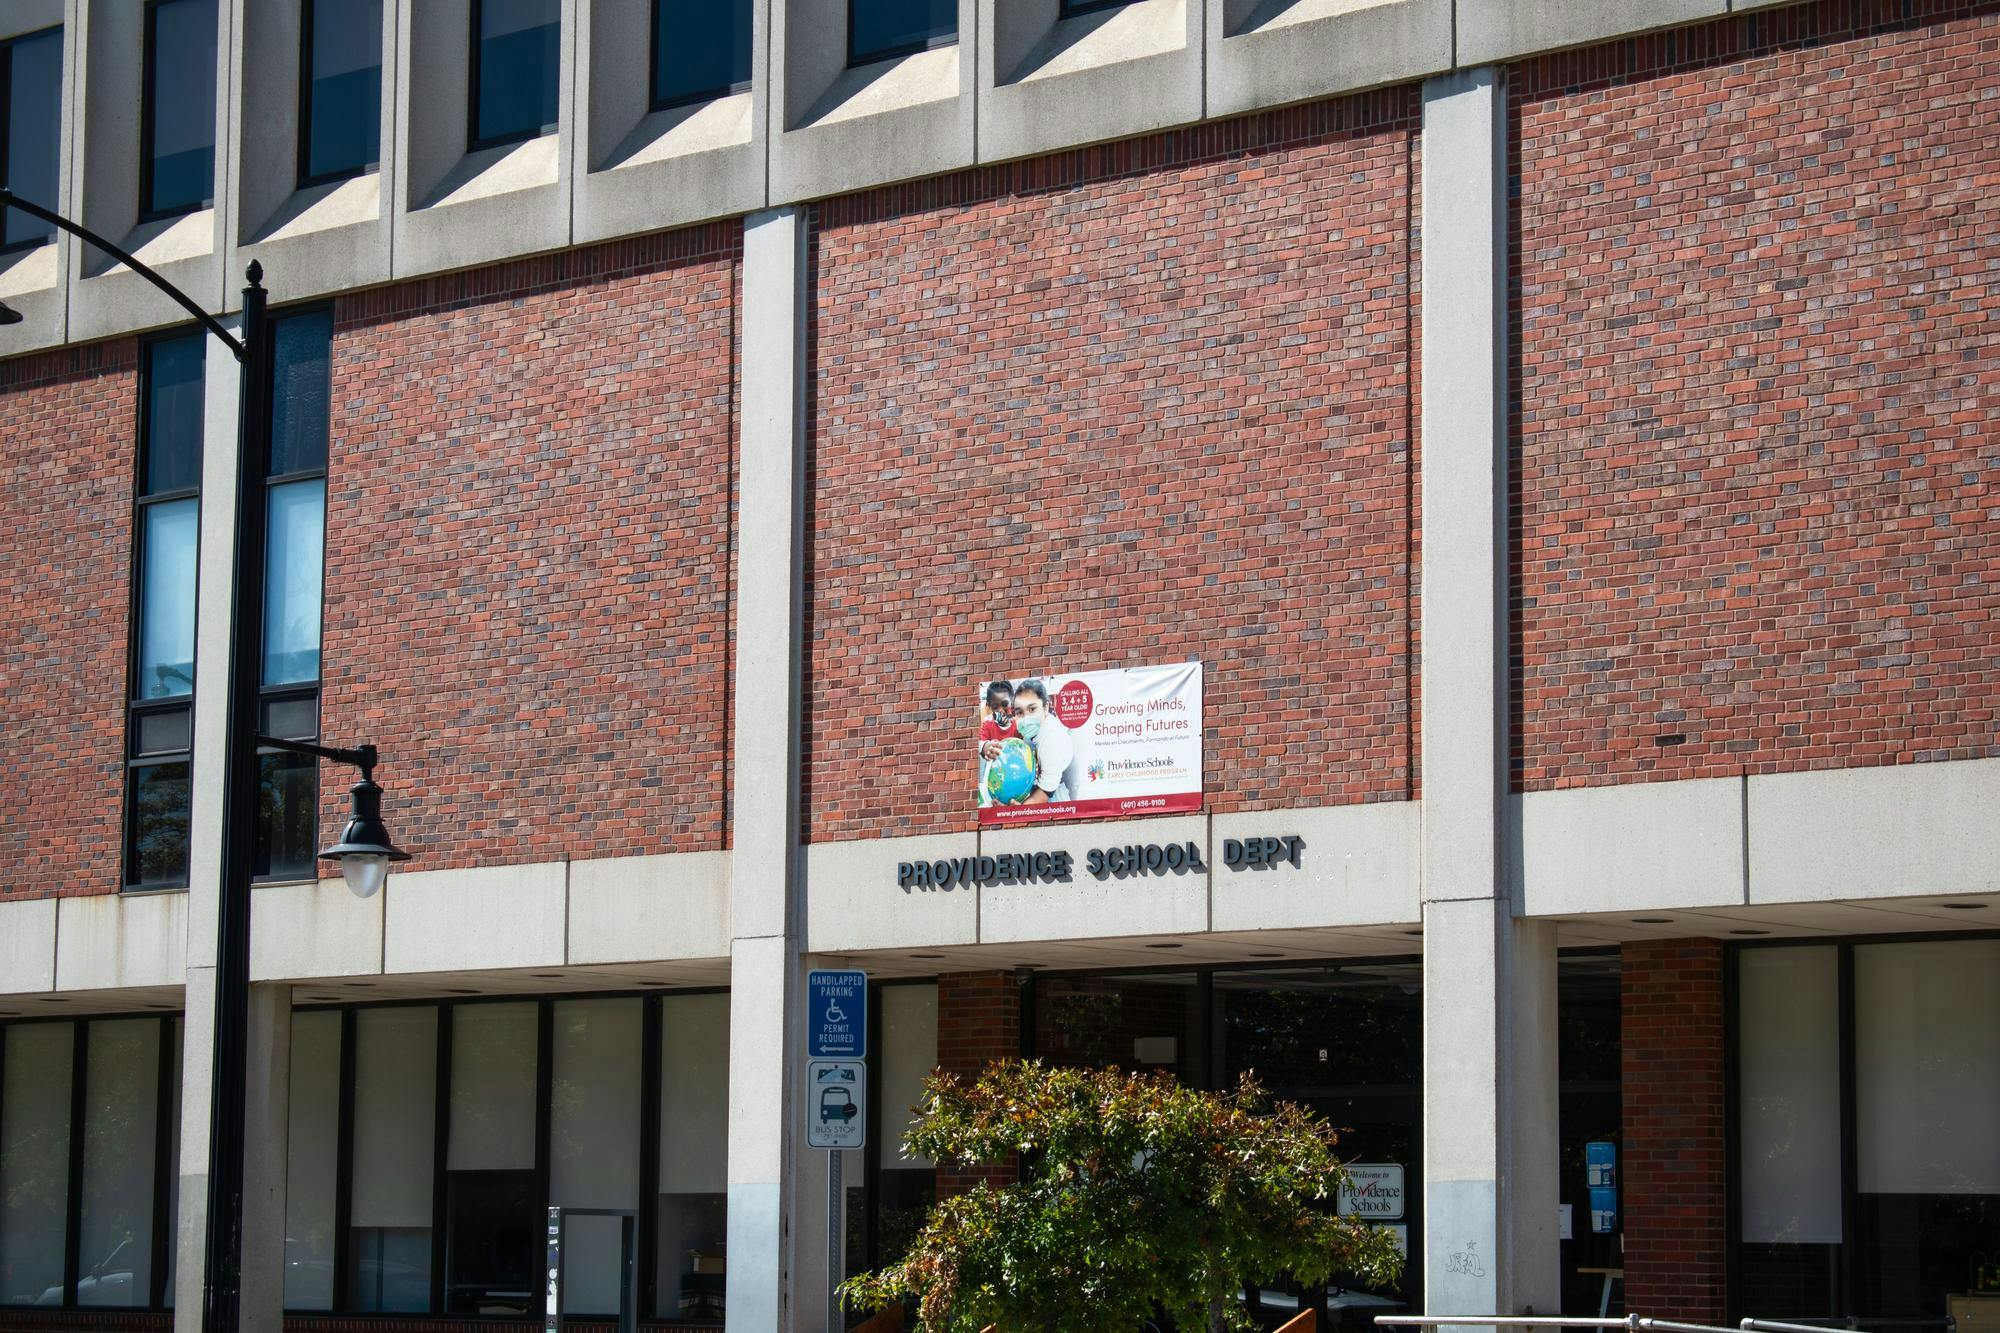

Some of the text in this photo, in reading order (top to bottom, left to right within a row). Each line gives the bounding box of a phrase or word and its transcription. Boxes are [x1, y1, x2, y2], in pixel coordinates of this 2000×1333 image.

[1082, 695, 1088, 703] 5
[1095, 702, 1143, 716] Growing
[1147, 697, 1186, 711] Minds,
[1095, 718, 1189, 737] Shaping Futures
[1107, 756, 1174, 771] Providence Schools
[1108, 771, 1125, 779] EARLY
[1126, 768, 1158, 777] CHILDHOOD
[1160, 767, 1188, 775] PROGRAM
[1121, 799, 1166, 809] (401) 456-9100
[996, 806, 1076, 818] www.providenceschools.org
[898, 835, 1300, 886] PROVIDENCE SCHOOL DEPT
[821, 986, 853, 997] PARKING
[823, 1024, 849, 1033] PERMIT
[819, 1033, 854, 1043] REQUIRED
[815, 1125, 856, 1134] BUS STOP
[1350, 1170, 1390, 1179] Welcome to
[1342, 1181, 1400, 1197] Providence
[1350, 1198, 1391, 1212] Schools
